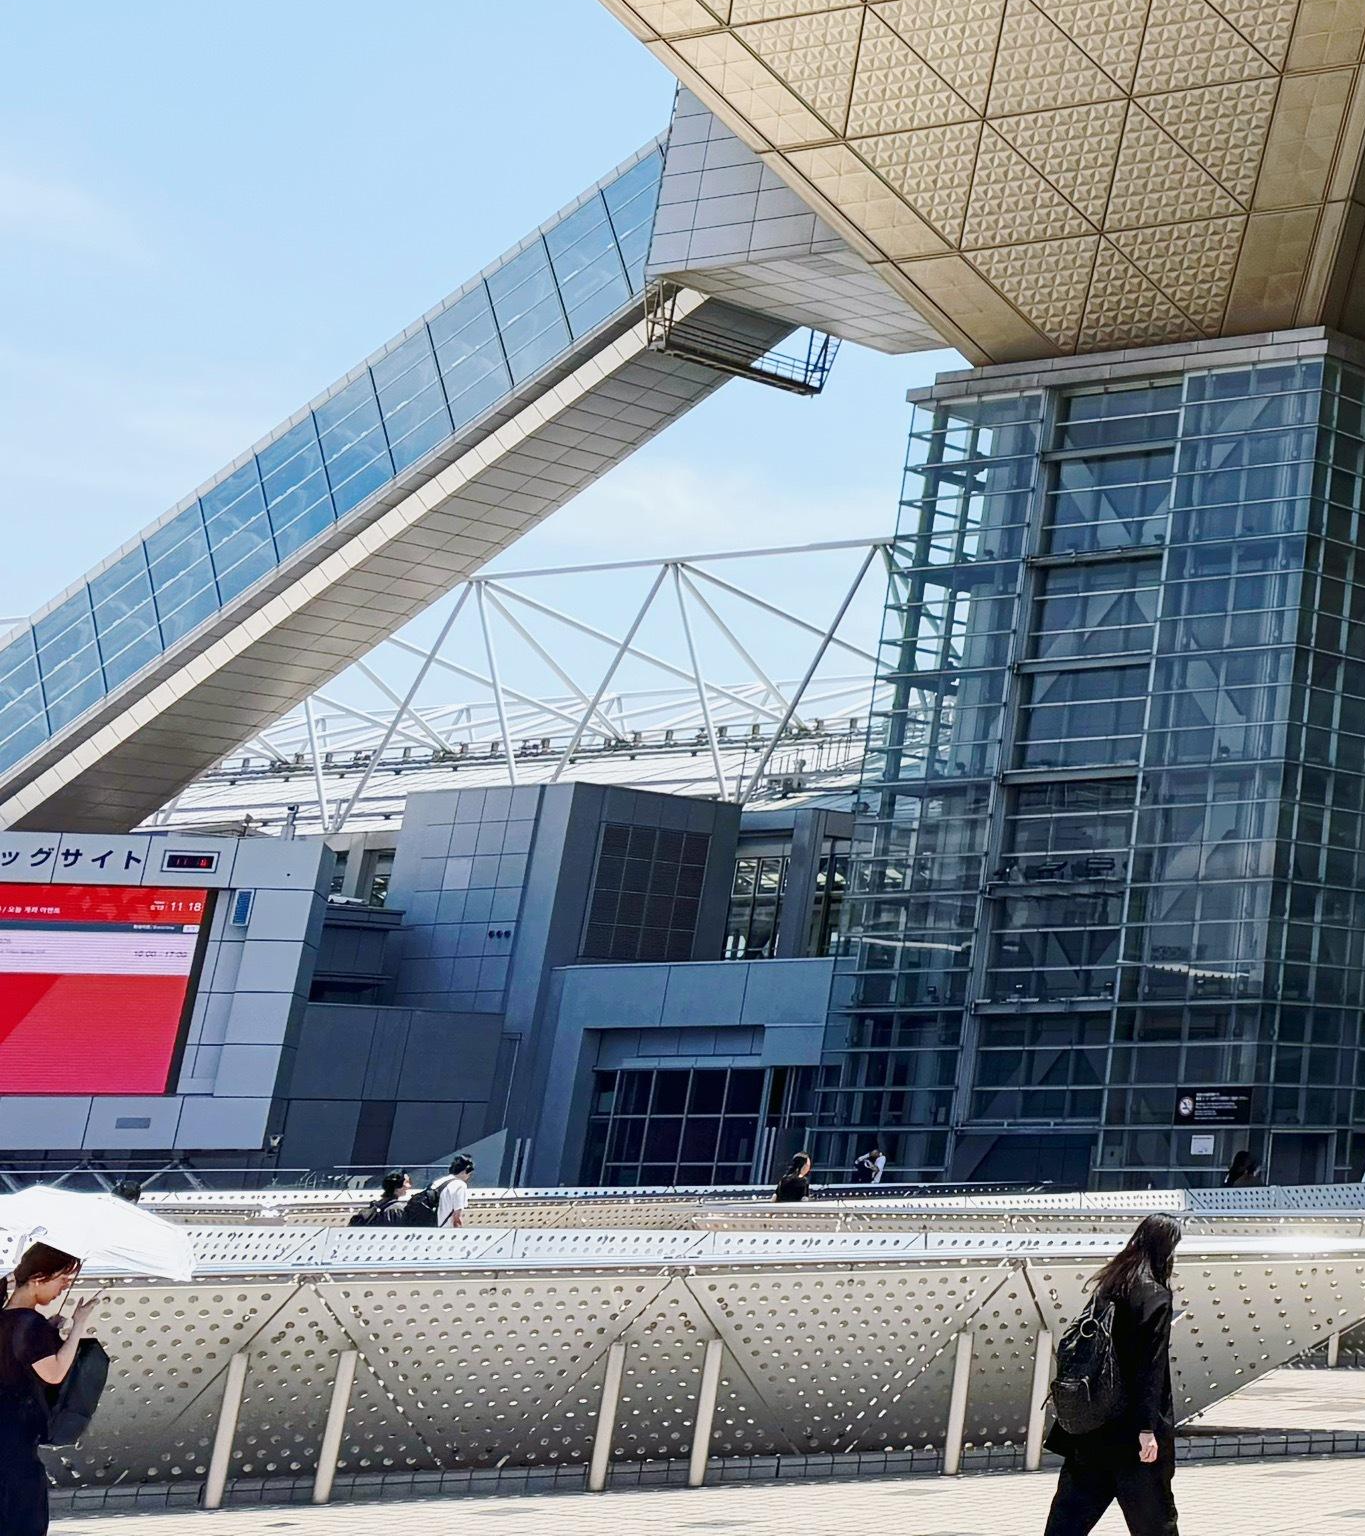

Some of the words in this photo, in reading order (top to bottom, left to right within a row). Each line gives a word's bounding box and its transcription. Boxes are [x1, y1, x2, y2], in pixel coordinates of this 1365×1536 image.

[2, 847, 142, 870] ッグサイト
